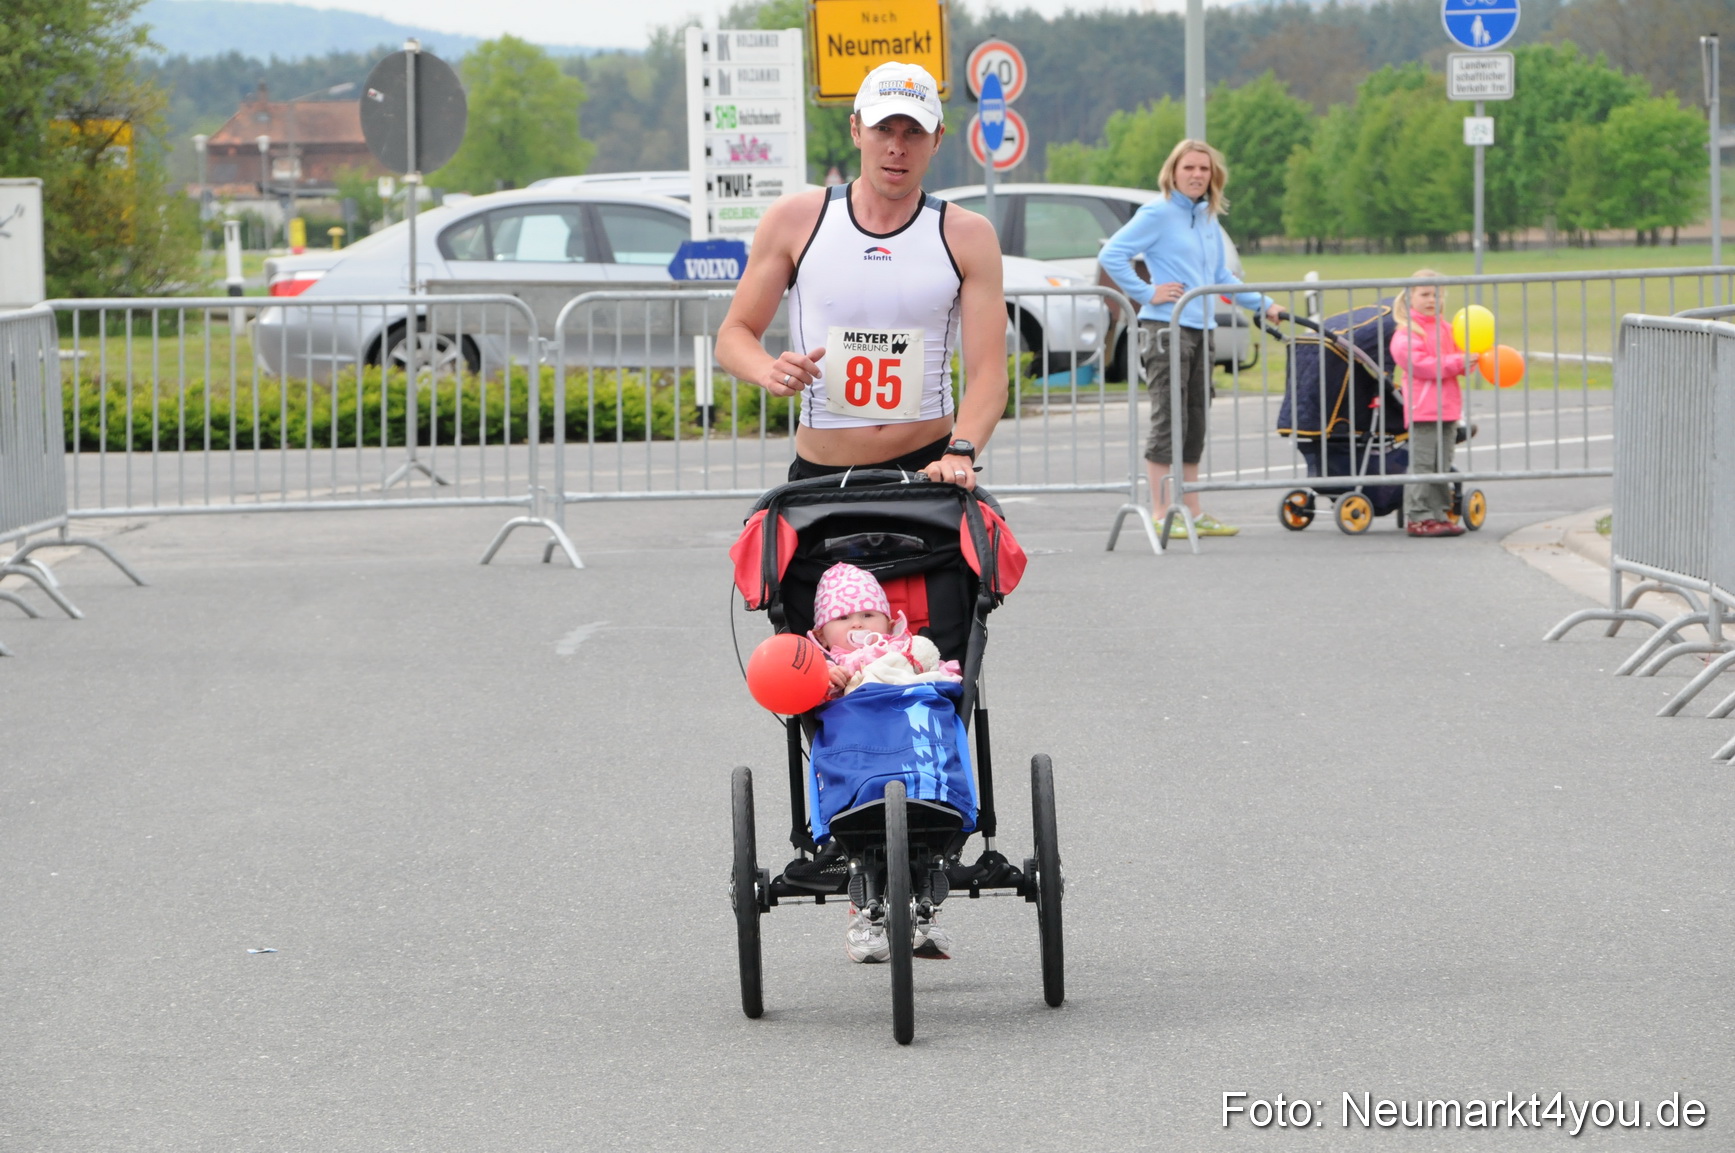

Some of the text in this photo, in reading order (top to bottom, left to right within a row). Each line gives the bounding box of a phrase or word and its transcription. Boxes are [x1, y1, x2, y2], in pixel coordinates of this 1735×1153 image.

[861, 11, 898, 23] Nach
[827, 30, 932, 57] Neumarkt
[1456, 71, 1506, 82] schaftlicher
[1456, 83, 1488, 93] Verkehr
[717, 173, 753, 197] THULE
[684, 258, 739, 279] VOLVO
[843, 332, 888, 344] MEYER
[843, 343, 889, 352] WERBUNG
[845, 356, 902, 410] 85
